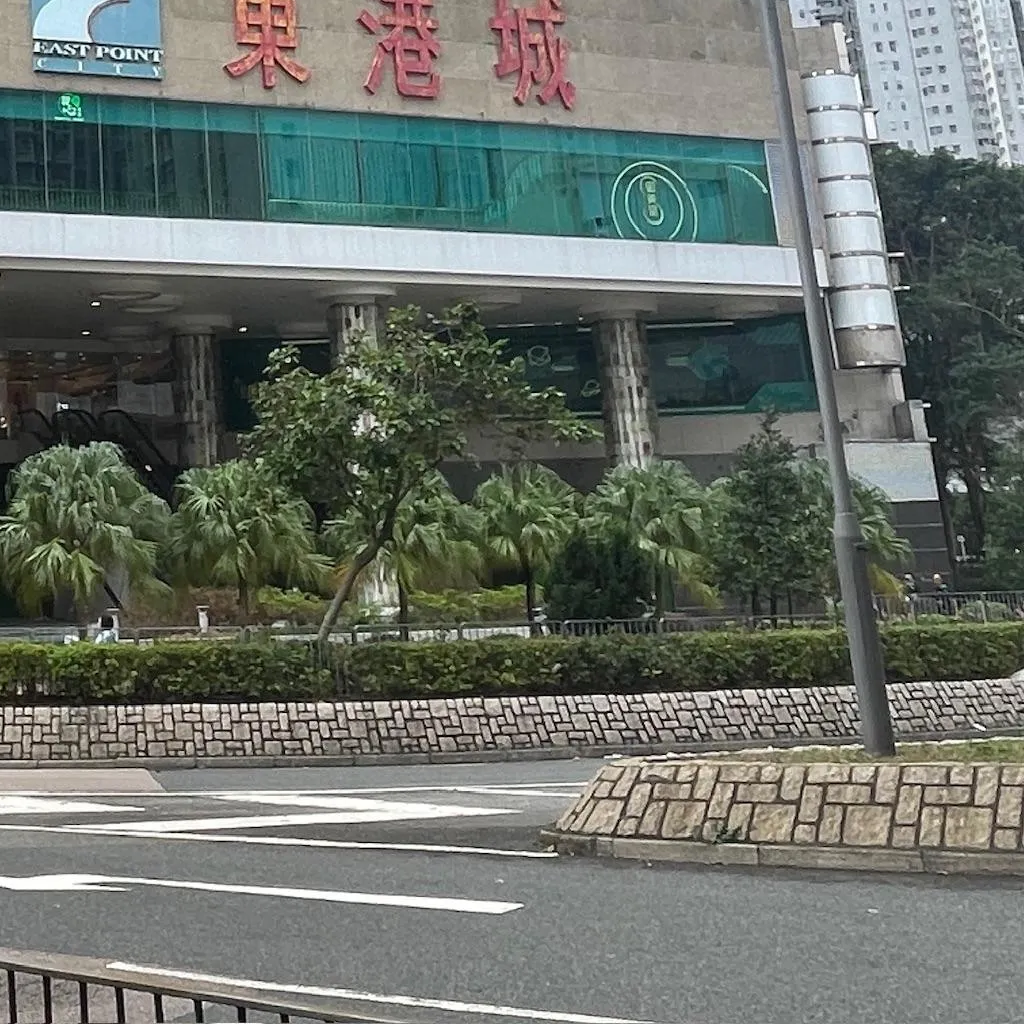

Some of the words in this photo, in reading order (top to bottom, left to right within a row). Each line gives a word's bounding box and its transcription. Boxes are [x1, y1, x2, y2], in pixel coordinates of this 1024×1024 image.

[33, 41, 91, 58] EAST
[95, 45, 164, 63] POINT
[36, 57, 162, 77] CITY
